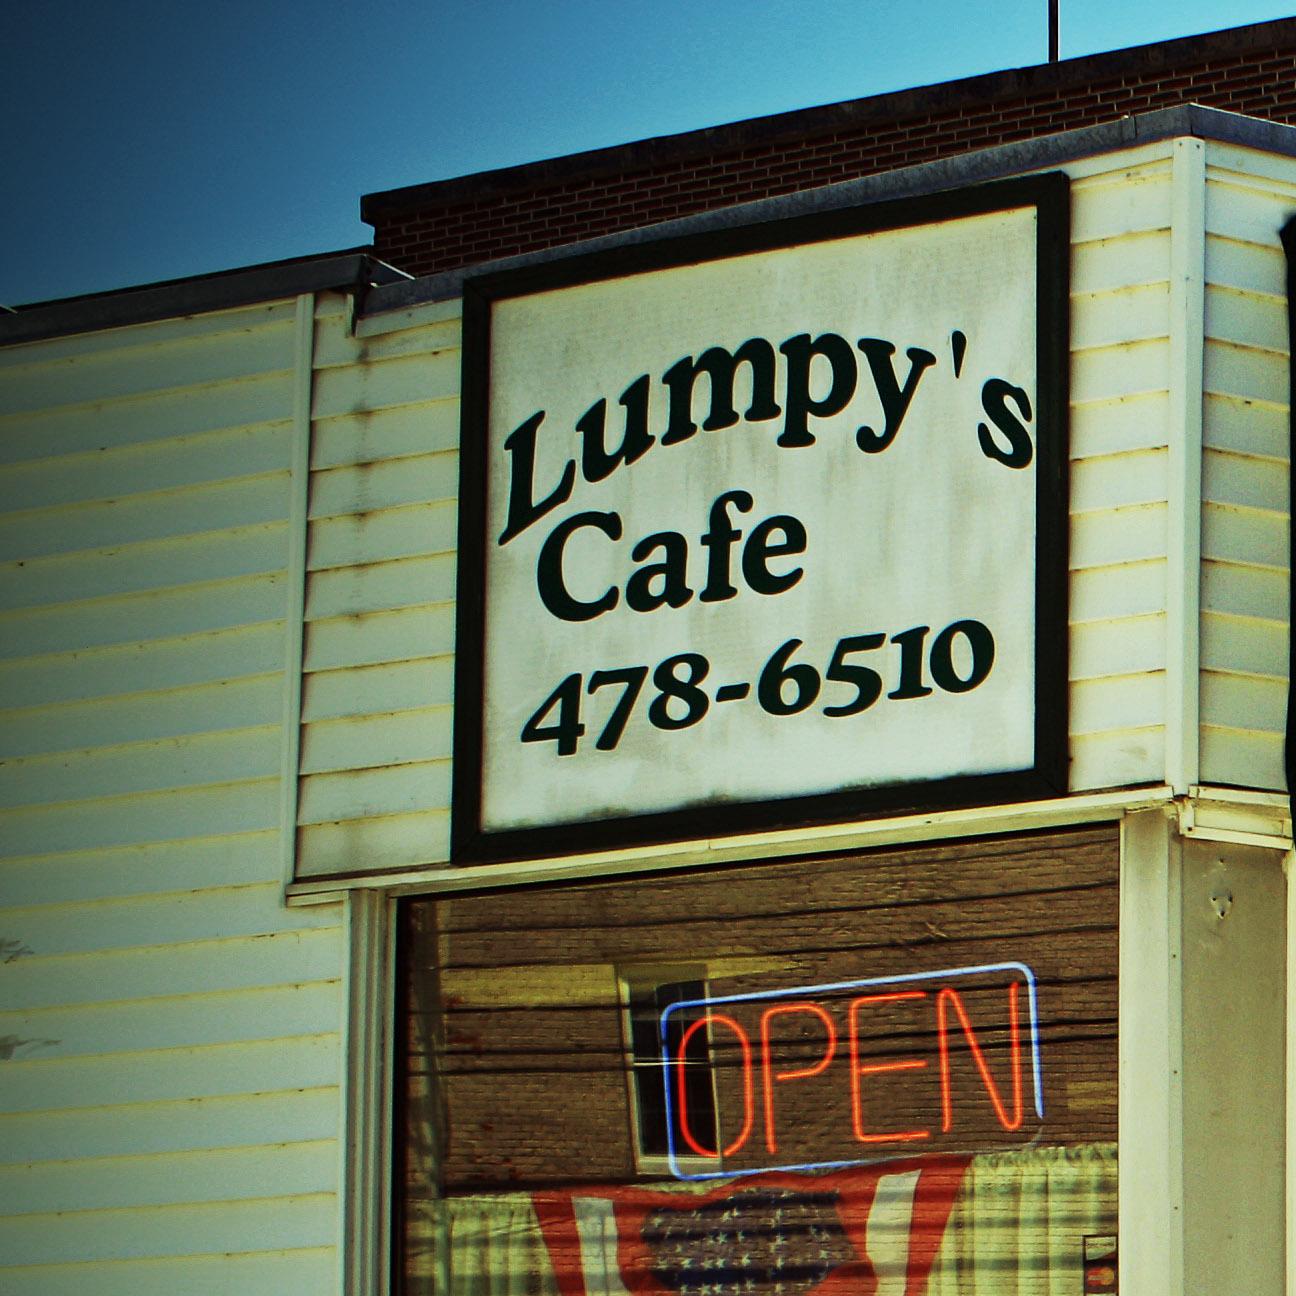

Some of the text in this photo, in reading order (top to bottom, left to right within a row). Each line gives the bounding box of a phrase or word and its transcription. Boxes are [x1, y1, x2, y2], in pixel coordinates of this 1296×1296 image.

[498, 330, 1033, 546] Lumpy's
[537, 490, 807, 622] Cafe
[520, 618, 995, 757] 478-6510
[677, 982, 1023, 1159] OPEN
